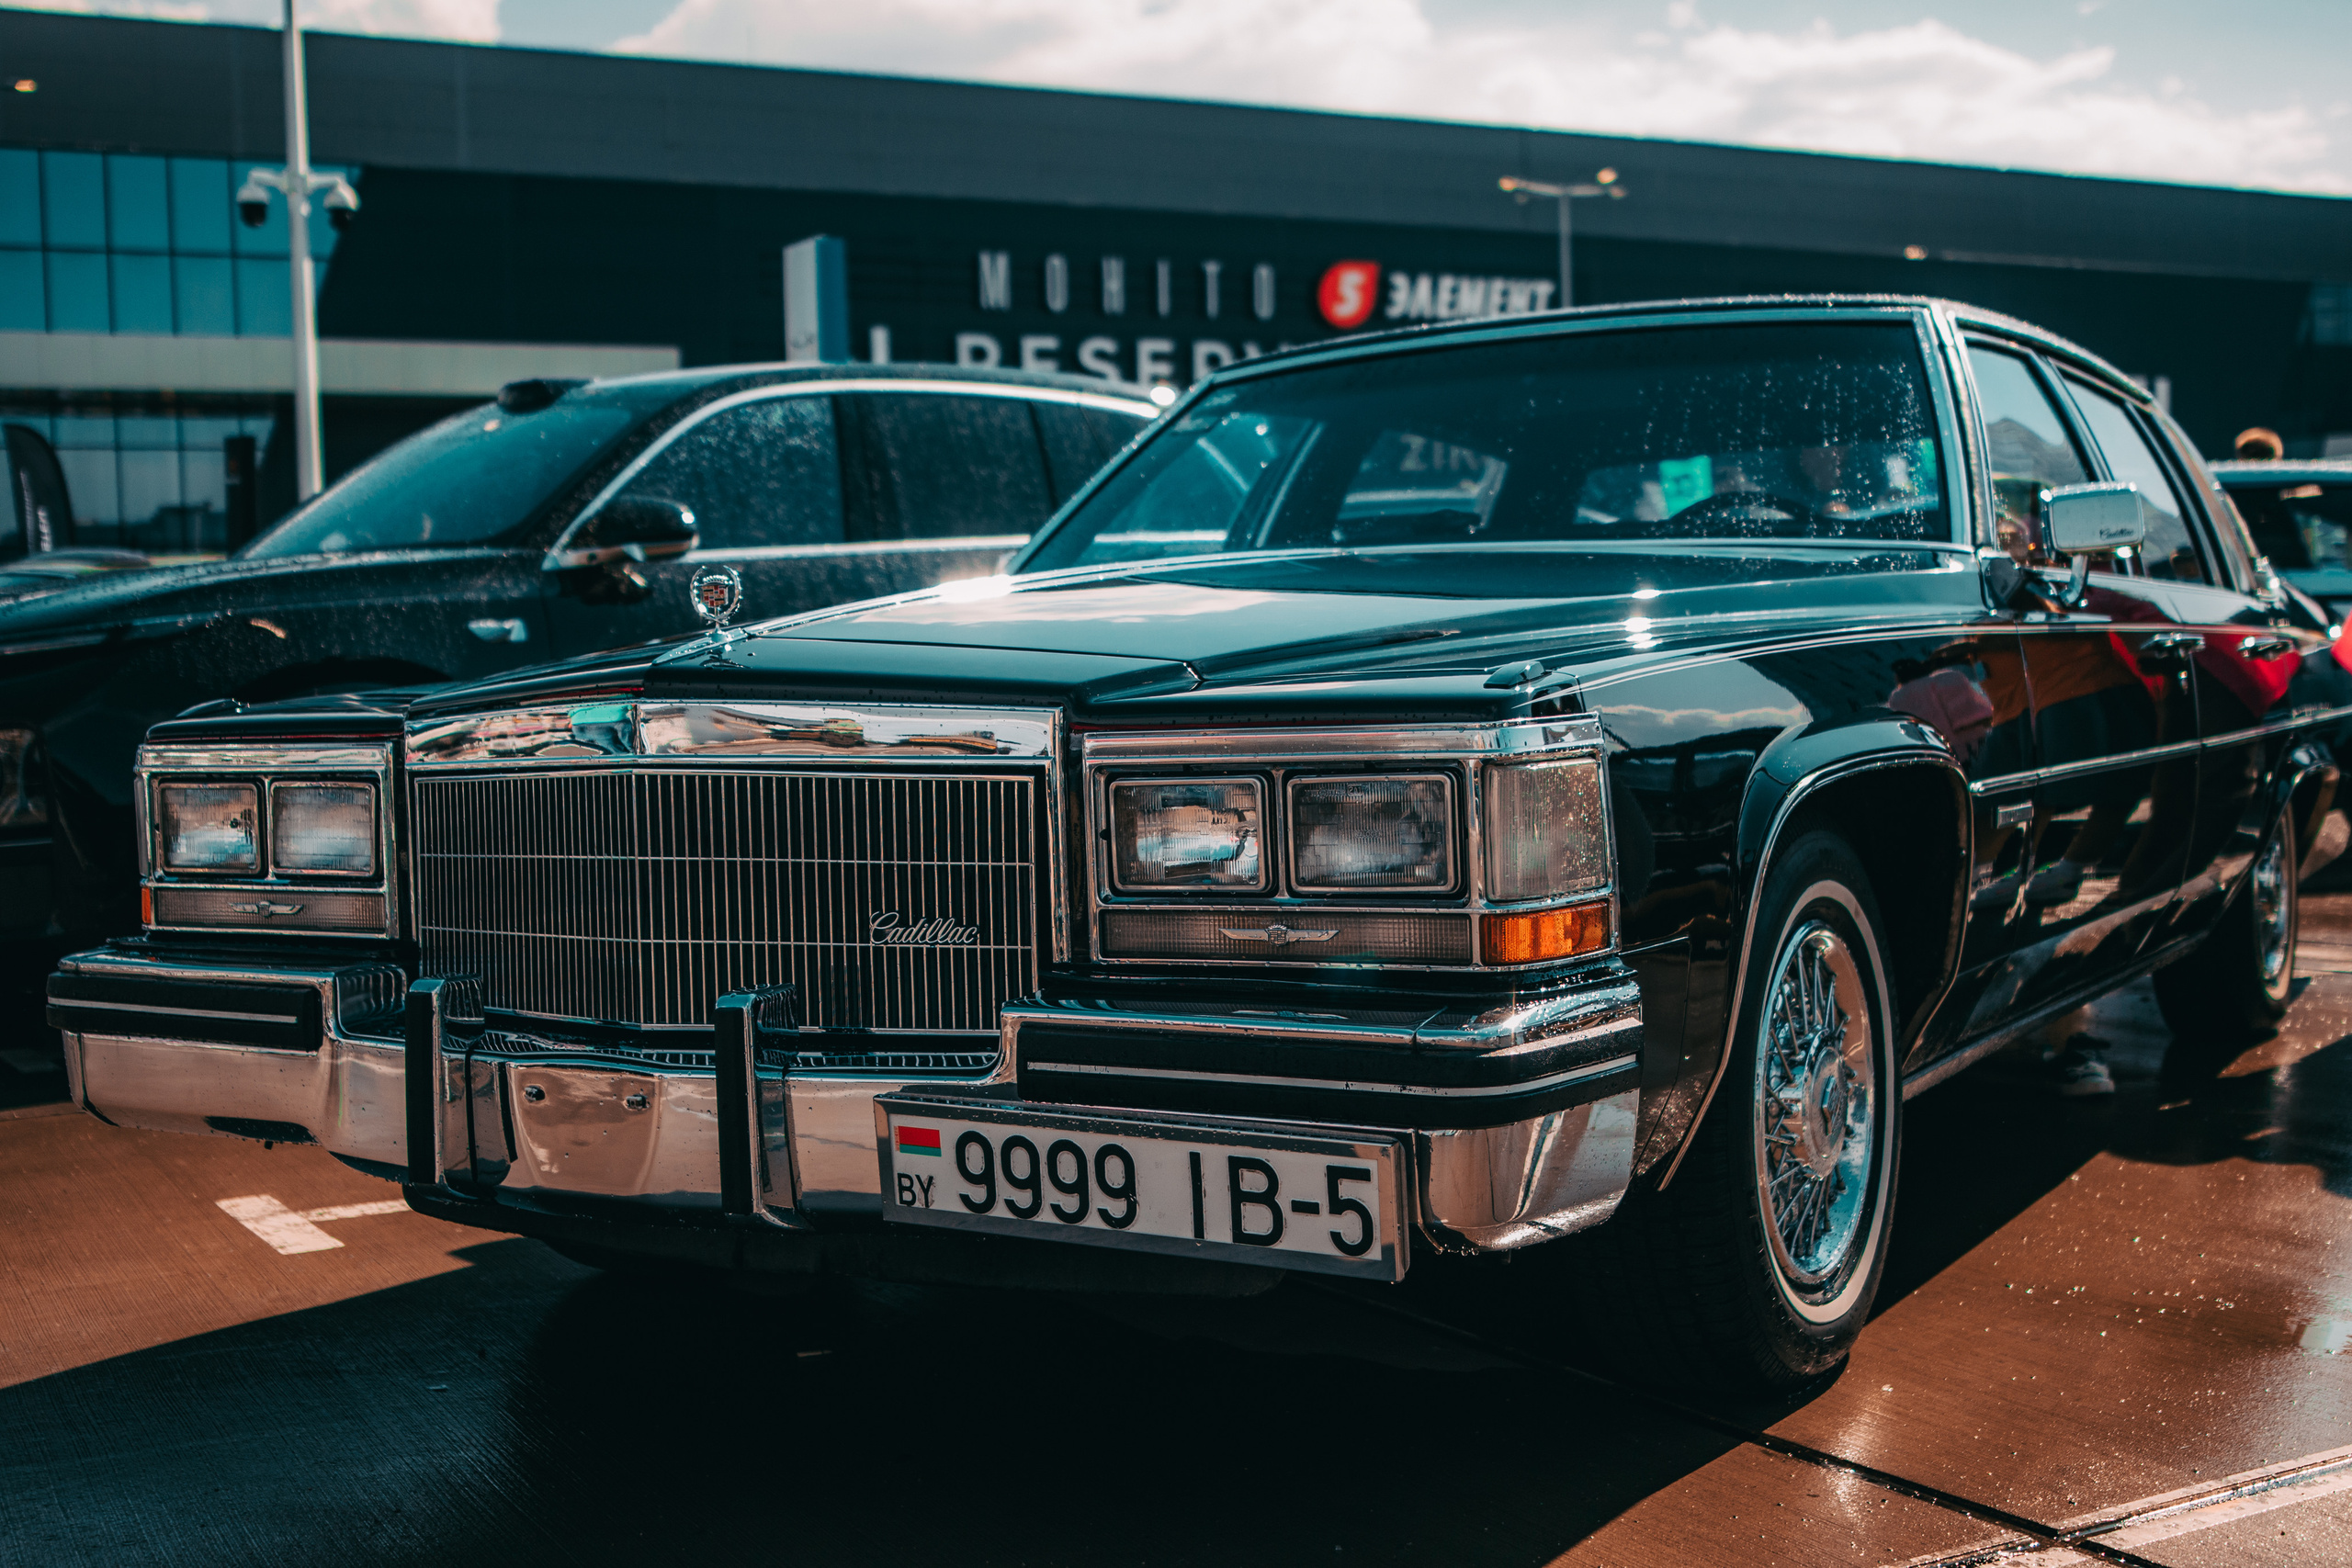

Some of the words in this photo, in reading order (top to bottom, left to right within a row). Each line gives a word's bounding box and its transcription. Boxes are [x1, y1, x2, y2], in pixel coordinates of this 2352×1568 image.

[978, 250, 1276, 320] MOHITO
[1385, 272, 1555, 318] ЭЛЕМЕНТ
[869, 910, 978, 944] Cadillac
[897, 1172, 934, 1209] BY
[955, 1130, 1137, 1230] 9999
